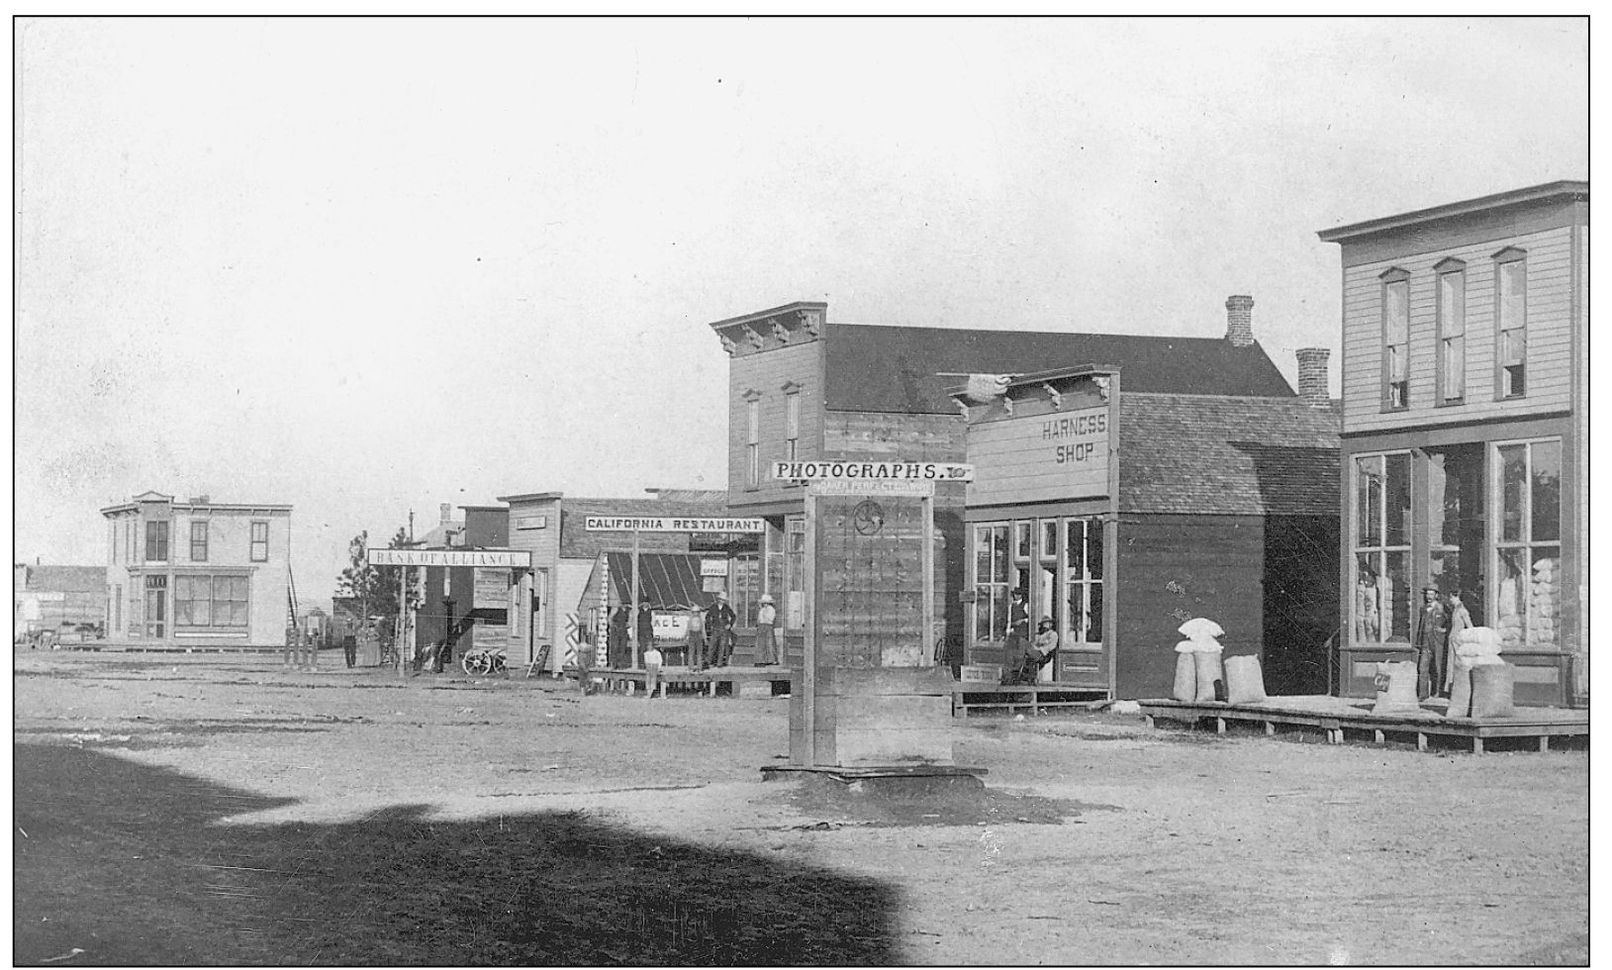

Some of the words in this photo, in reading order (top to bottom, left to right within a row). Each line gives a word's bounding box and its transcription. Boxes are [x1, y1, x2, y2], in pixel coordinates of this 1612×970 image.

[1043, 413, 1106, 440] HARNESS
[1056, 442, 1094, 464] SHOP
[587, 518, 663, 529] CALIFORNIA
[376, 551, 417, 564] BANK
[420, 552, 437, 565] OF
[441, 553, 516, 565] ALLIANCE
